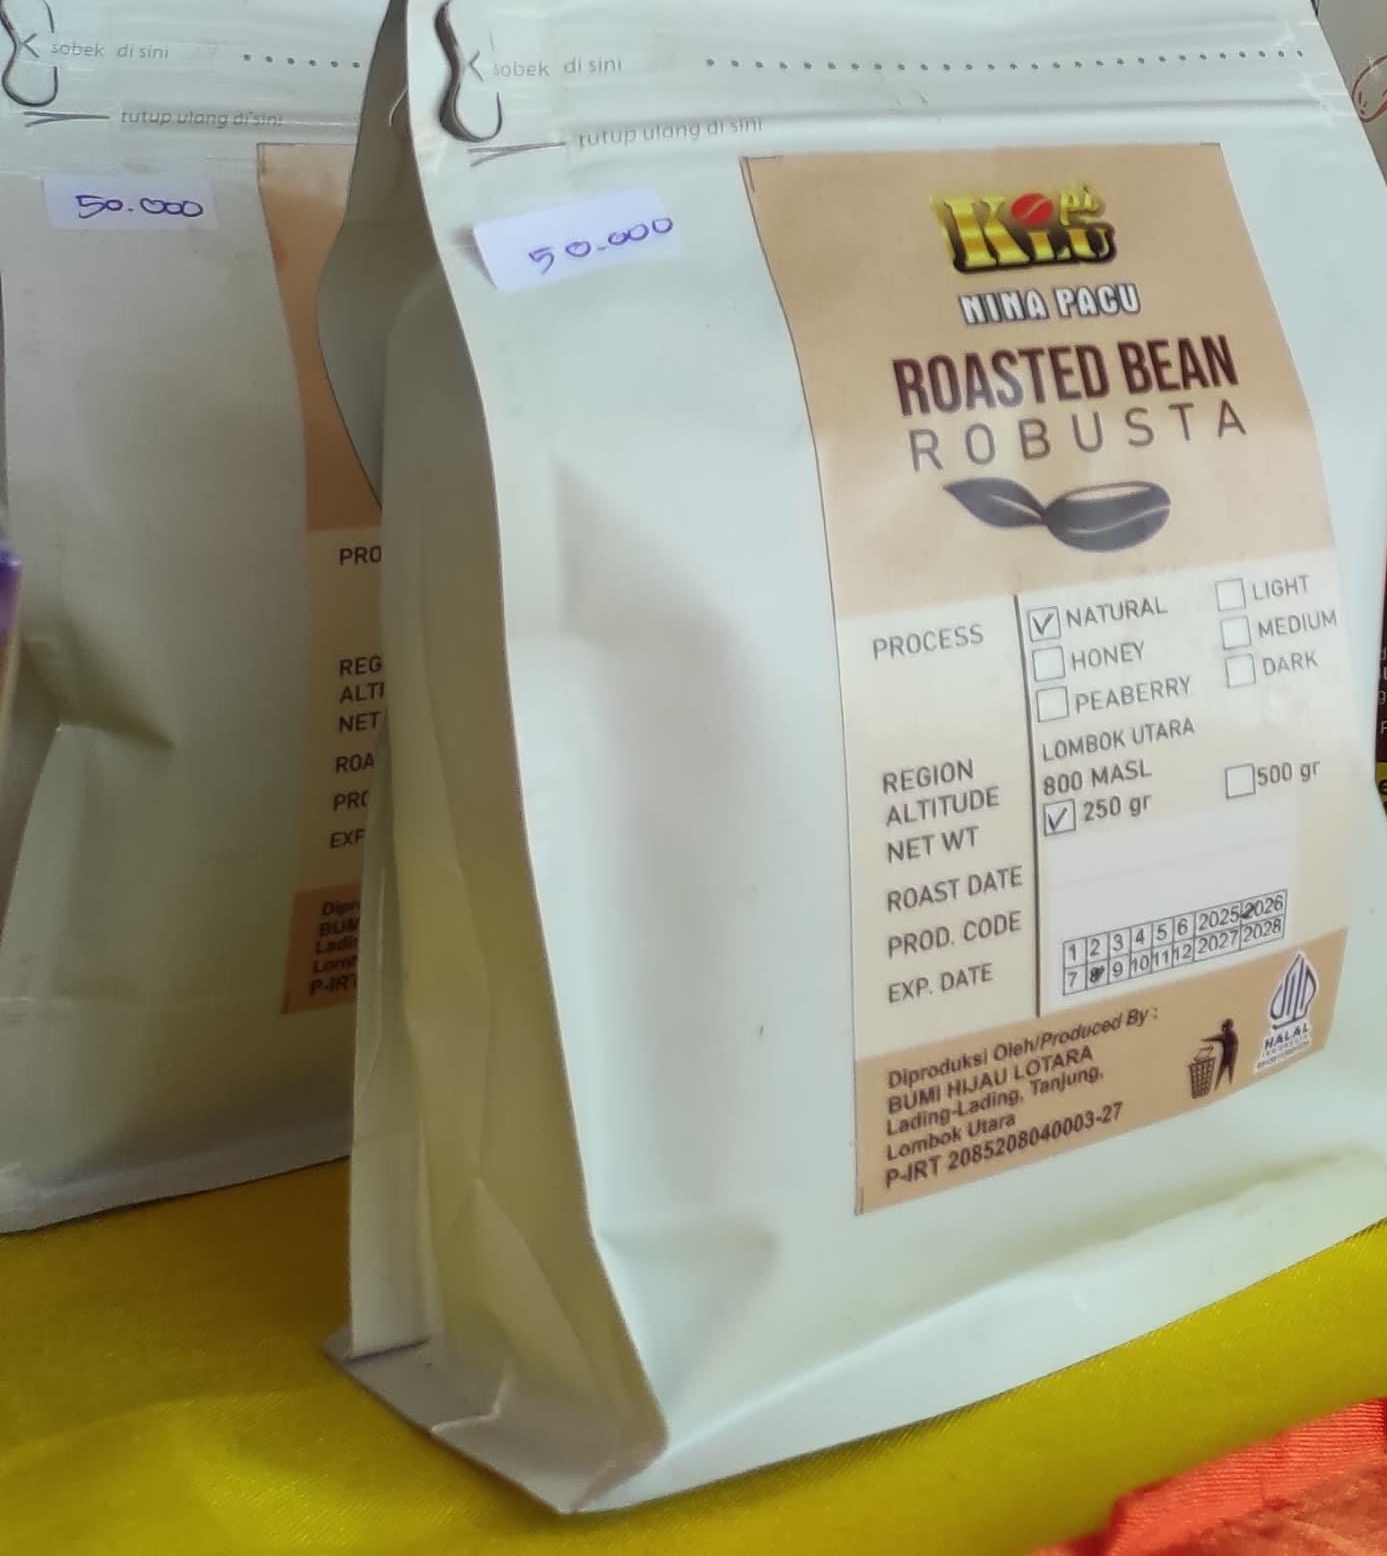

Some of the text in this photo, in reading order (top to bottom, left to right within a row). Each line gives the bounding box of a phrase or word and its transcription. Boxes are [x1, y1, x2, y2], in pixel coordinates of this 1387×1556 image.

[51, 41, 104, 60] sobek
[494, 59, 551, 78] sobek
[120, 108, 170, 129] tutup
[173, 110, 229, 131] ulang
[579, 124, 638, 149] tutup
[643, 120, 701, 143] ulang
[75, 194, 205, 221] 50.000
[528, 216, 675, 276] 50.000
[958, 282, 1142, 325] NINA PACU
[892, 333, 1240, 417] ROASTED BEAN
[908, 398, 1247, 473] ROBUSTA
[872, 574, 1311, 661] PROCESS NATURAL LIGHT
[1071, 609, 1338, 672] HONEY MEDIUM
[1075, 650, 1319, 714] PEABERRY DARK
[338, 711, 381, 734] NET
[882, 716, 1196, 795] REGION LOMBOK UTARA
[885, 759, 1153, 828] ALTITUDE 800 MASL
[887, 760, 1321, 864] NET WT 250 gr 500 gr
[887, 864, 1024, 914] ROAST DATE
[888, 910, 1022, 959] PROD. CODE
[1068, 946, 1077, 962] 1
[1090, 938, 1101, 957] 2
[1112, 933, 1124, 952] 3
[1134, 929, 1145, 945] 4
[1156, 923, 1168, 941] 5
[1177, 918, 1189, 936] 6
[1198, 906, 1240, 932] 2025
[1068, 918, 1282, 988] 7 9 10 11 12 2027 2028
[888, 962, 994, 1005] EXP. DATE
[888, 1015, 1122, 1089] Diproduksi Oleh/Produced
[1264, 1022, 1310, 1052] HALAL
[886, 1065, 1105, 1137] Lading-Lading, Tanjung,
[887, 1044, 1095, 1117] BUMI HIJAU LOTARA
[884, 1100, 1125, 1190] P-IRT 2085208040003-27
[885, 1112, 1018, 1163] Lombok Utara
